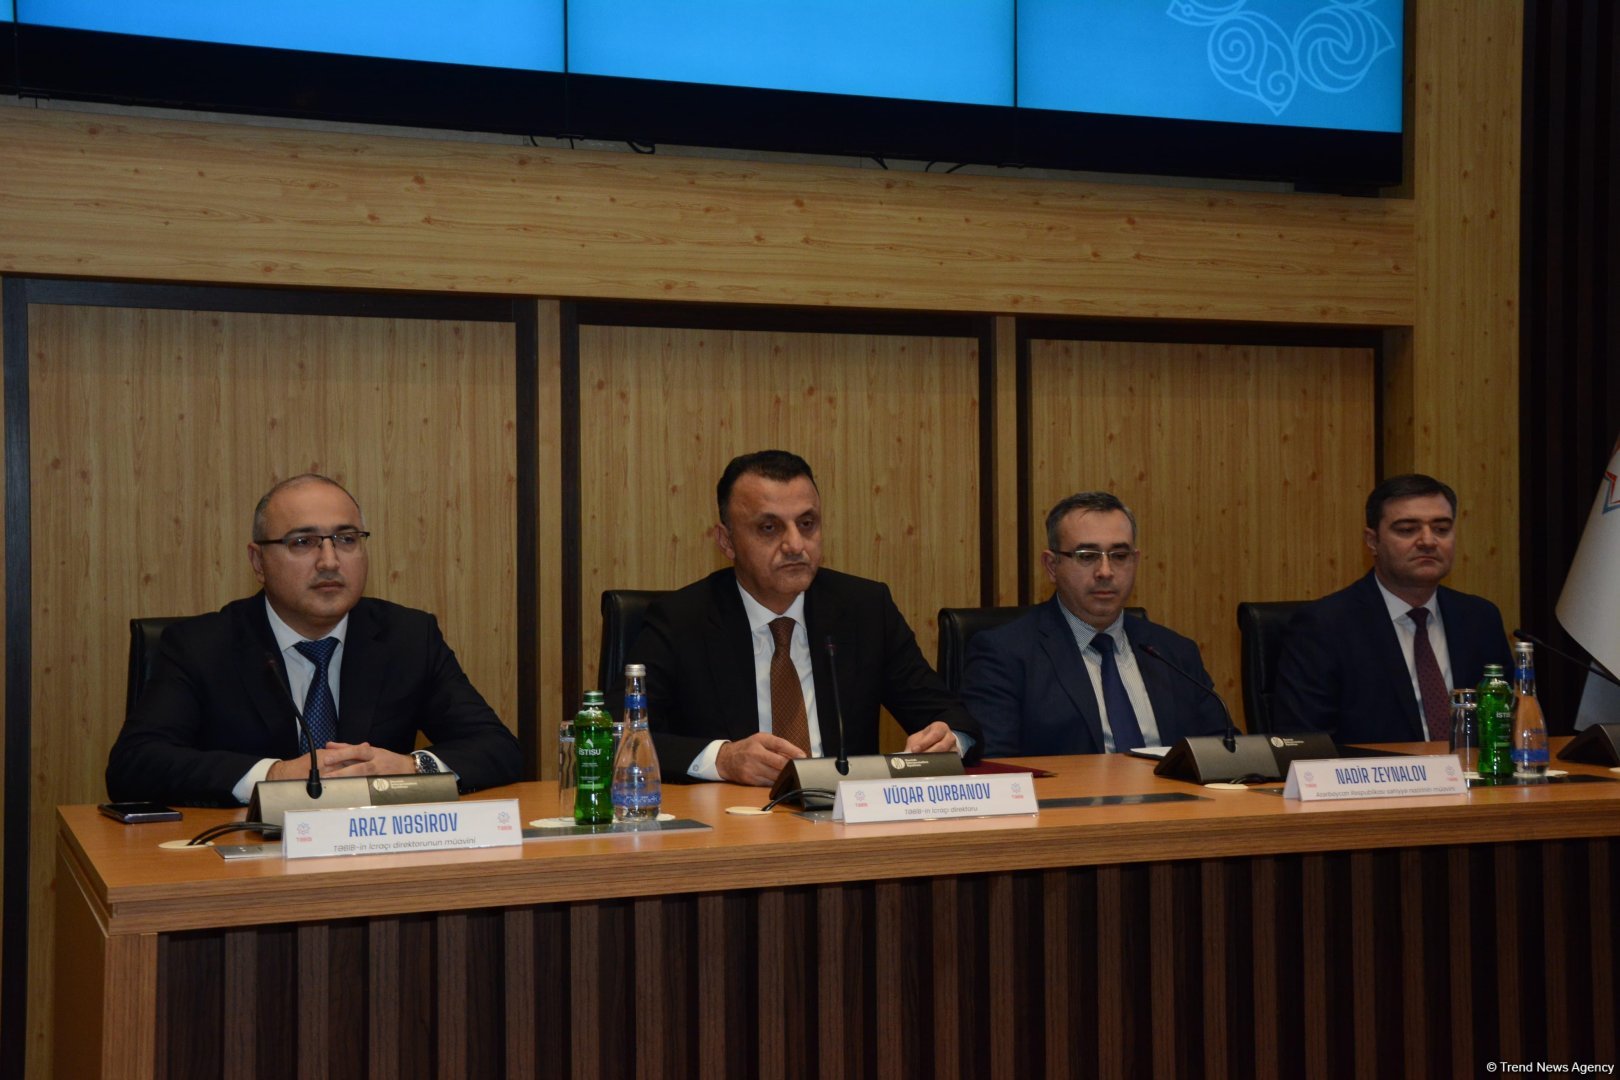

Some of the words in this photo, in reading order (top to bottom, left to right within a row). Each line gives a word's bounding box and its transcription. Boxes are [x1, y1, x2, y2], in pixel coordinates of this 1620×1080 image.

[1335, 765, 1370, 785] NADİR
[1371, 765, 1428, 784] ZEYNALOV
[883, 785, 925, 805] VÜQAR
[928, 782, 991, 804] QURBANOV
[348, 816, 388, 838] ARAZ
[393, 811, 458, 836] NƏSİROV
